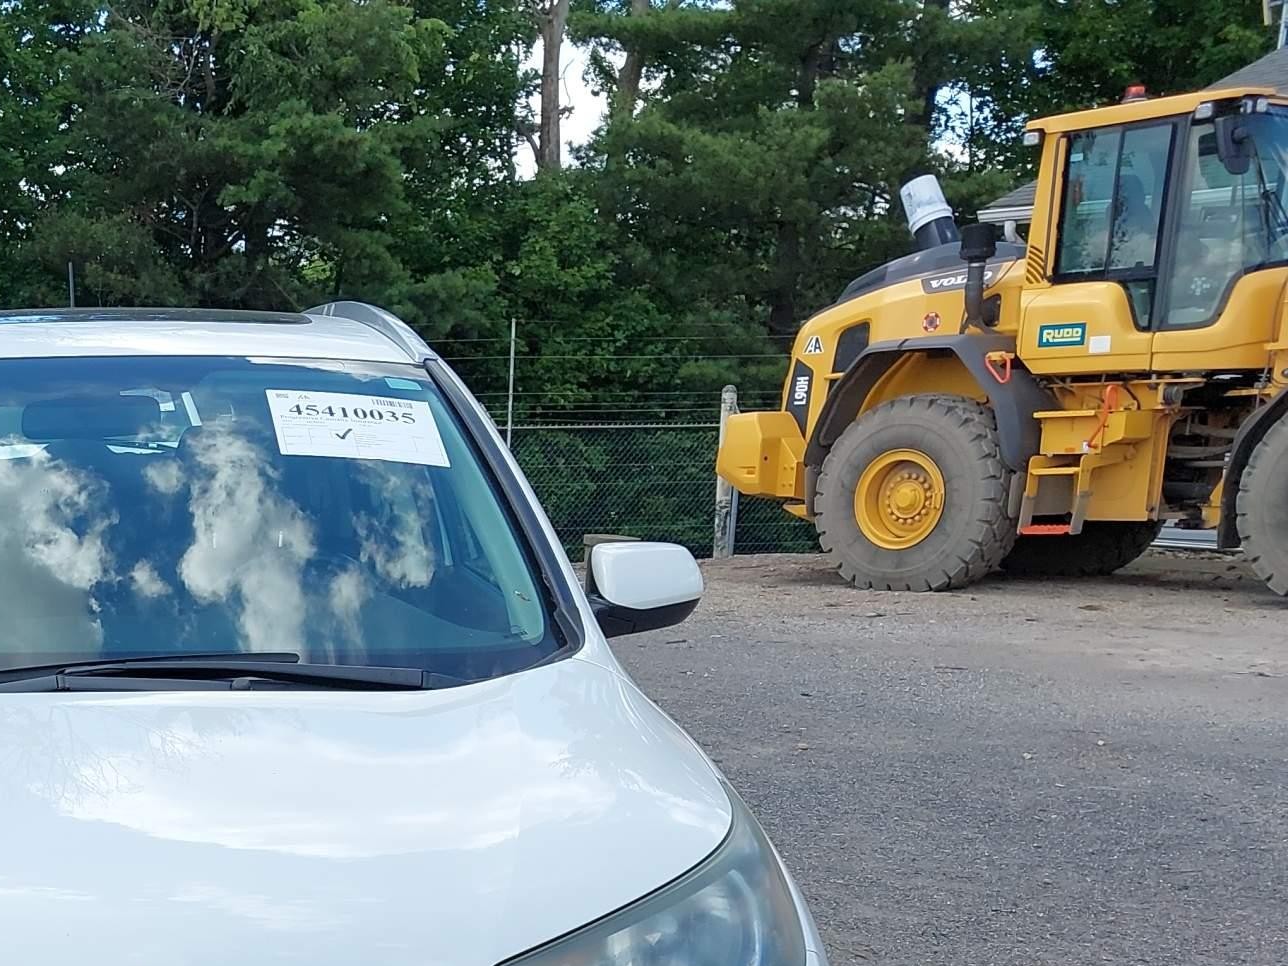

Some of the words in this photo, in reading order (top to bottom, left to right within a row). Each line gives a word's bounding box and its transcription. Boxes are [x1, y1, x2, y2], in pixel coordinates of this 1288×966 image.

[930, 271, 993, 288] VOLO
[1042, 327, 1082, 343] RUDD
[793, 376, 809, 405] L90H
[288, 404, 416, 425] 45410035
